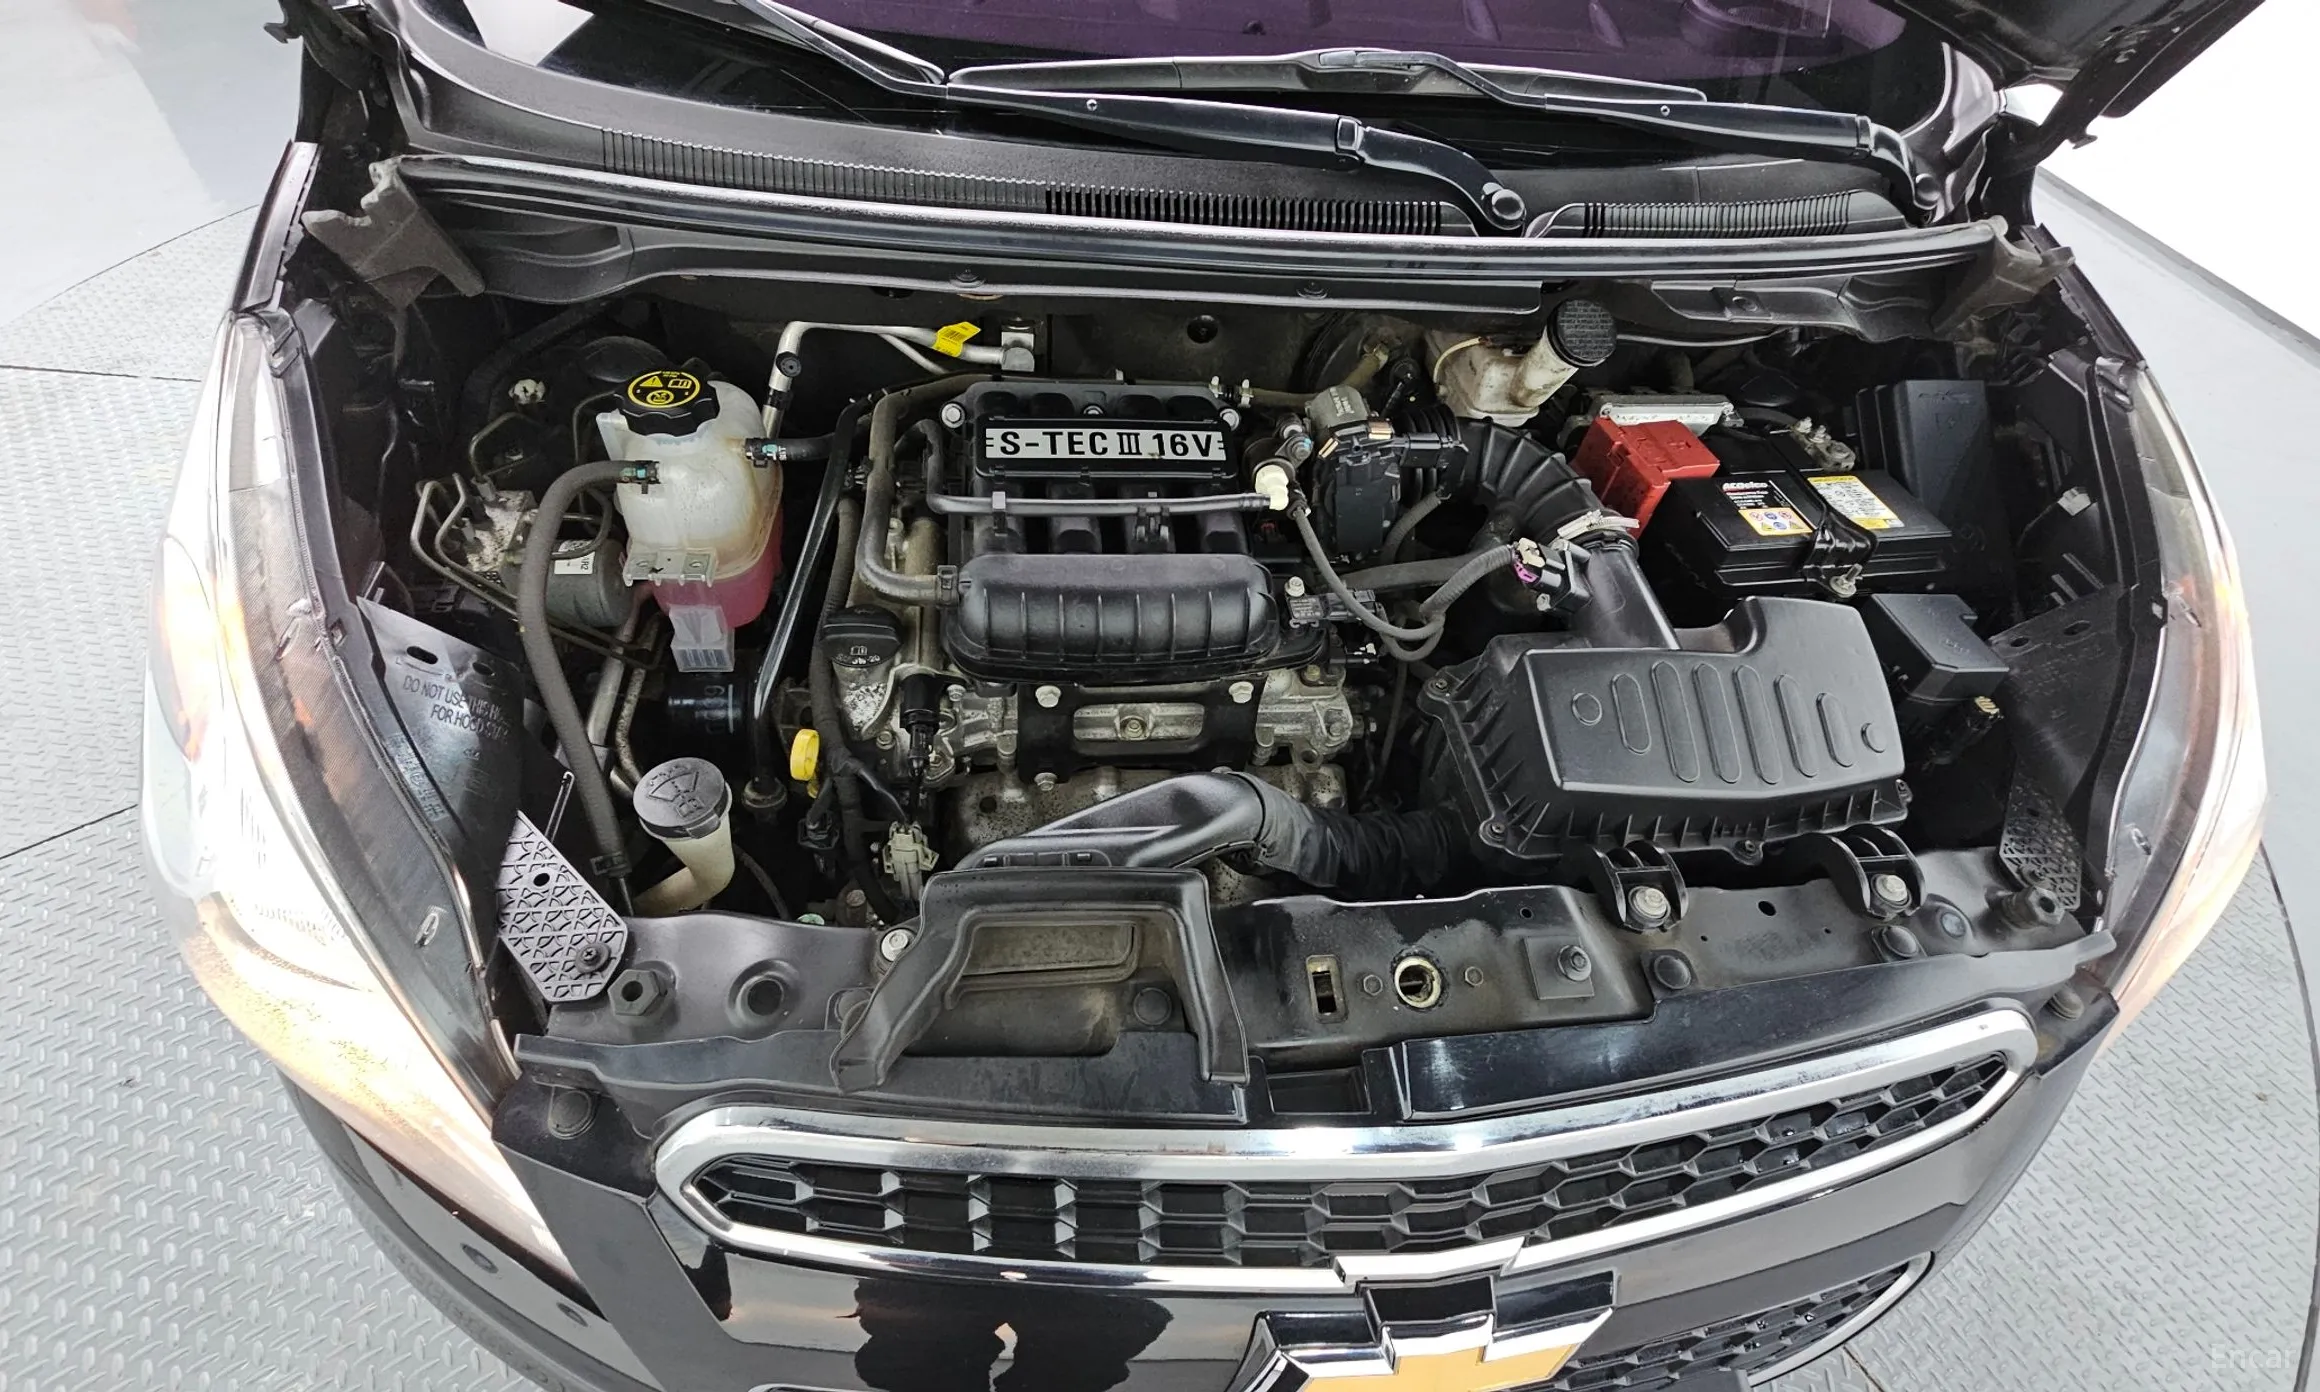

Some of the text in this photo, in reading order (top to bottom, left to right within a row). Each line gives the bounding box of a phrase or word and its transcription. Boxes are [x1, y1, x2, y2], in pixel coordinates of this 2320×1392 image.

[1000, 430, 1109, 456] S-TEC
[1153, 433, 1213, 458] 16V
[403, 675, 420, 693] DO
[421, 683, 445, 701] NOT
[445, 689, 466, 709] USE
[430, 704, 453, 723] FOR
